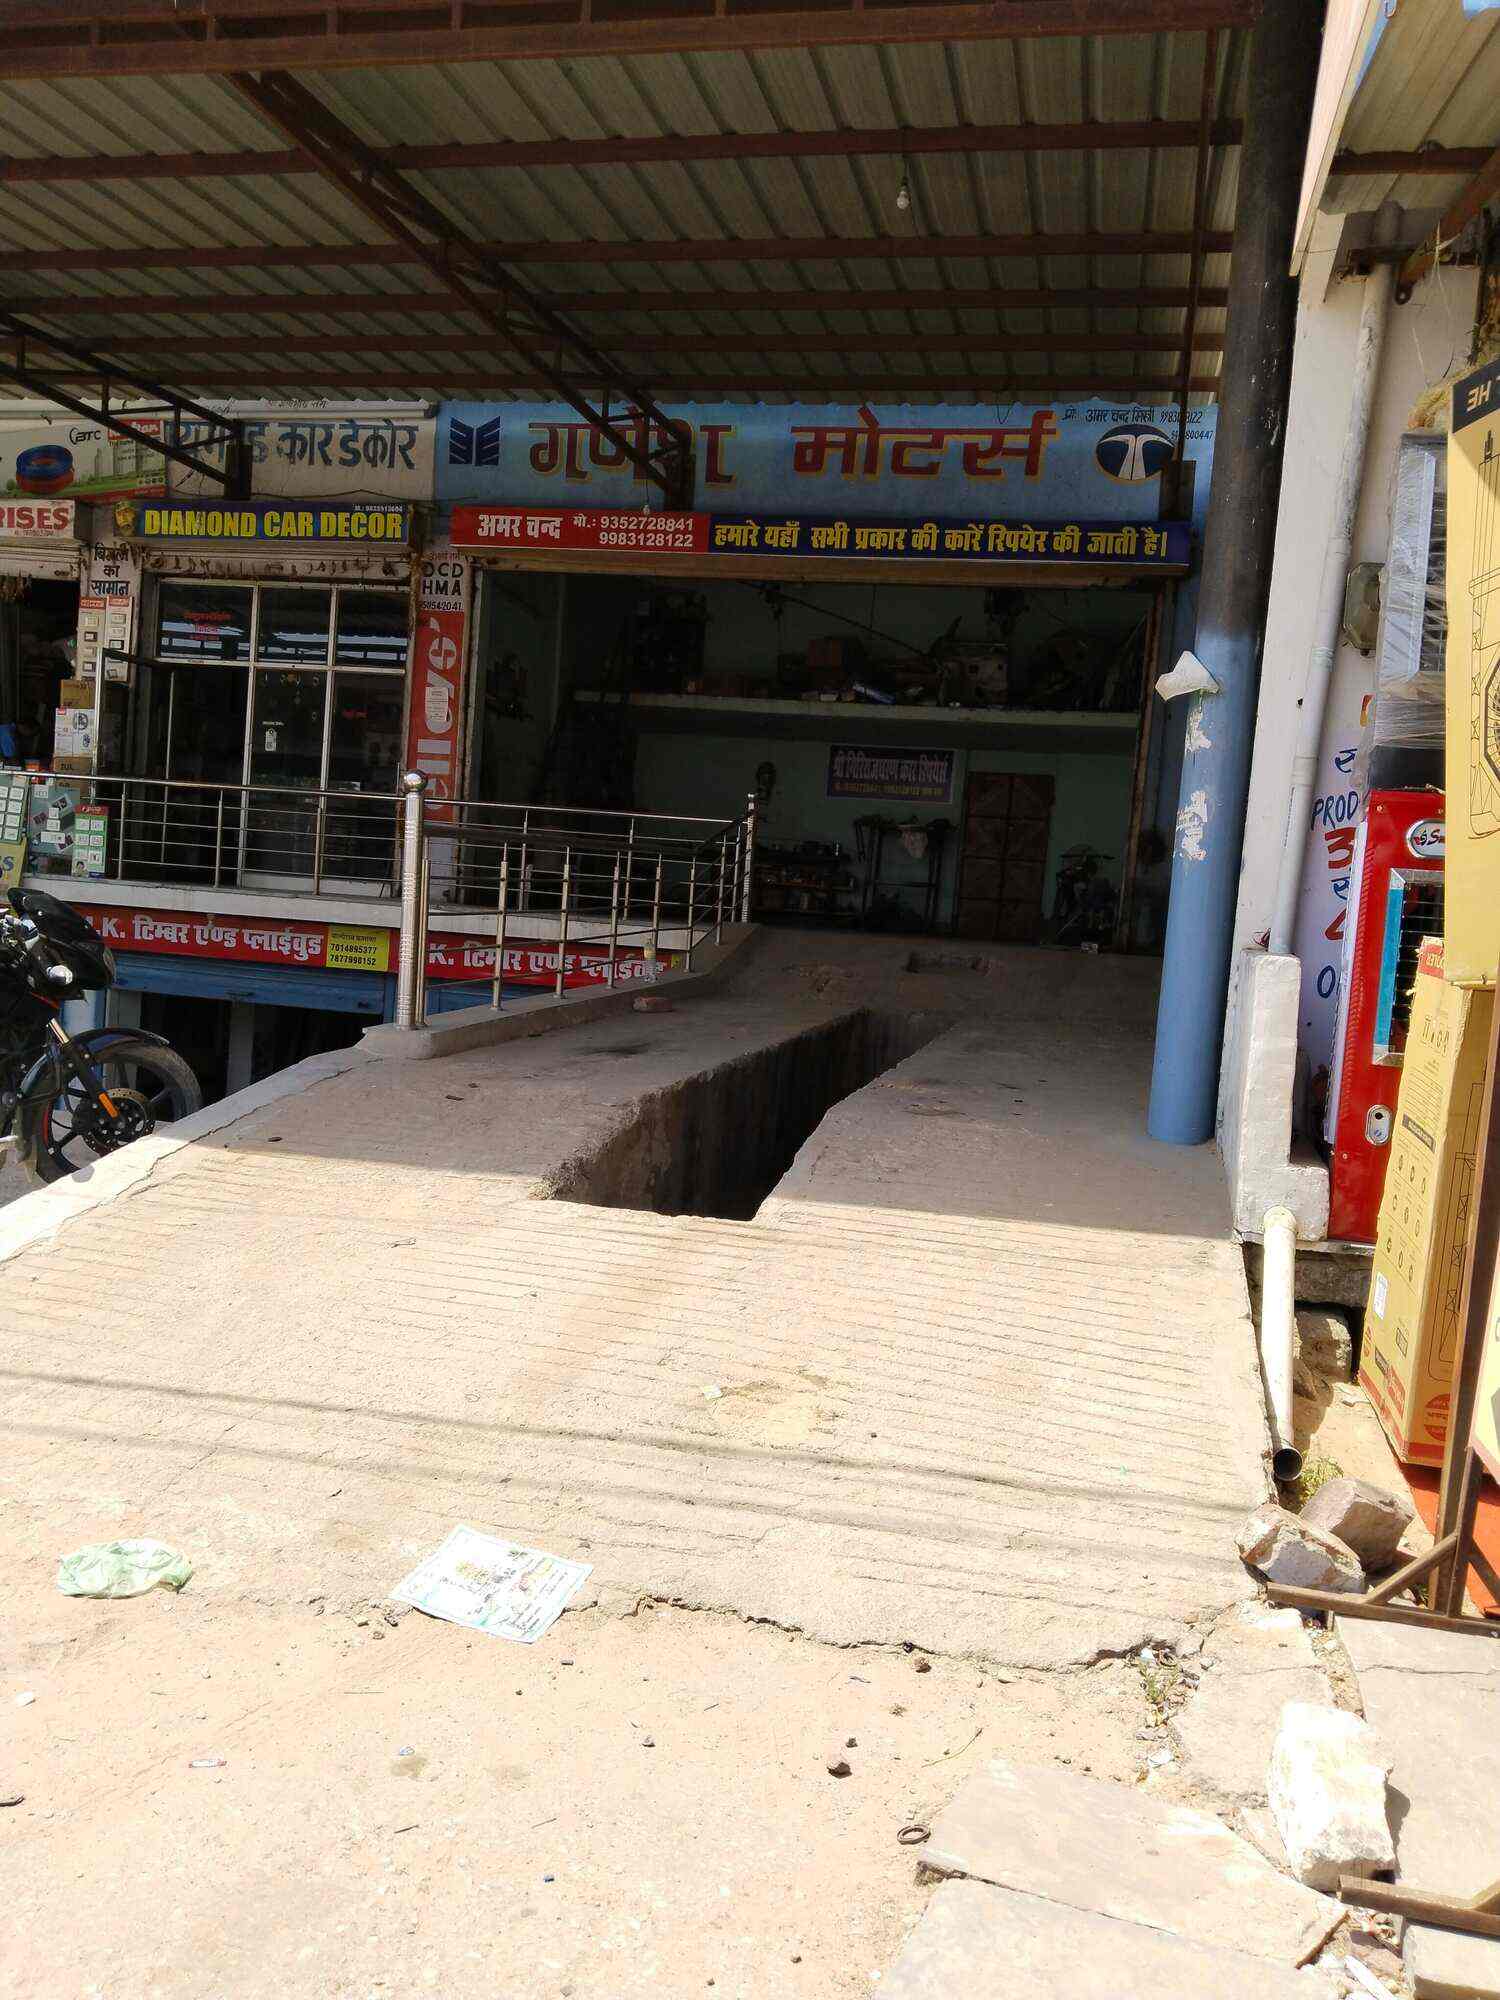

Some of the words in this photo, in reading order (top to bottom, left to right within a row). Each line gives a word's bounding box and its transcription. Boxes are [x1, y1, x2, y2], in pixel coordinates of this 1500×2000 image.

[278, 421, 336, 465] कार
[338, 418, 420, 470] डेकोर
[790, 406, 1058, 480] मोटर्स
[144, 510, 256, 537] DIAMOND
[263, 511, 313, 537] CAR
[319, 512, 403, 538] DECOR
[477, 513, 523, 539] अमर
[526, 515, 563, 541] चन्द
[600, 515, 694, 532] 9352728841
[714, 519, 760, 549] हमारे
[811, 520, 851, 550] सभी
[854, 526, 907, 552] प्रकार
[911, 522, 940, 552] की
[944, 523, 986, 553] कारें
[1052, 523, 1083, 553] की
[1087, 527, 1138, 556] जाती
[598, 531, 693, 547] 9983128122
[104, 565, 121, 578] का
[132, 914, 190, 945] टिम्बर
